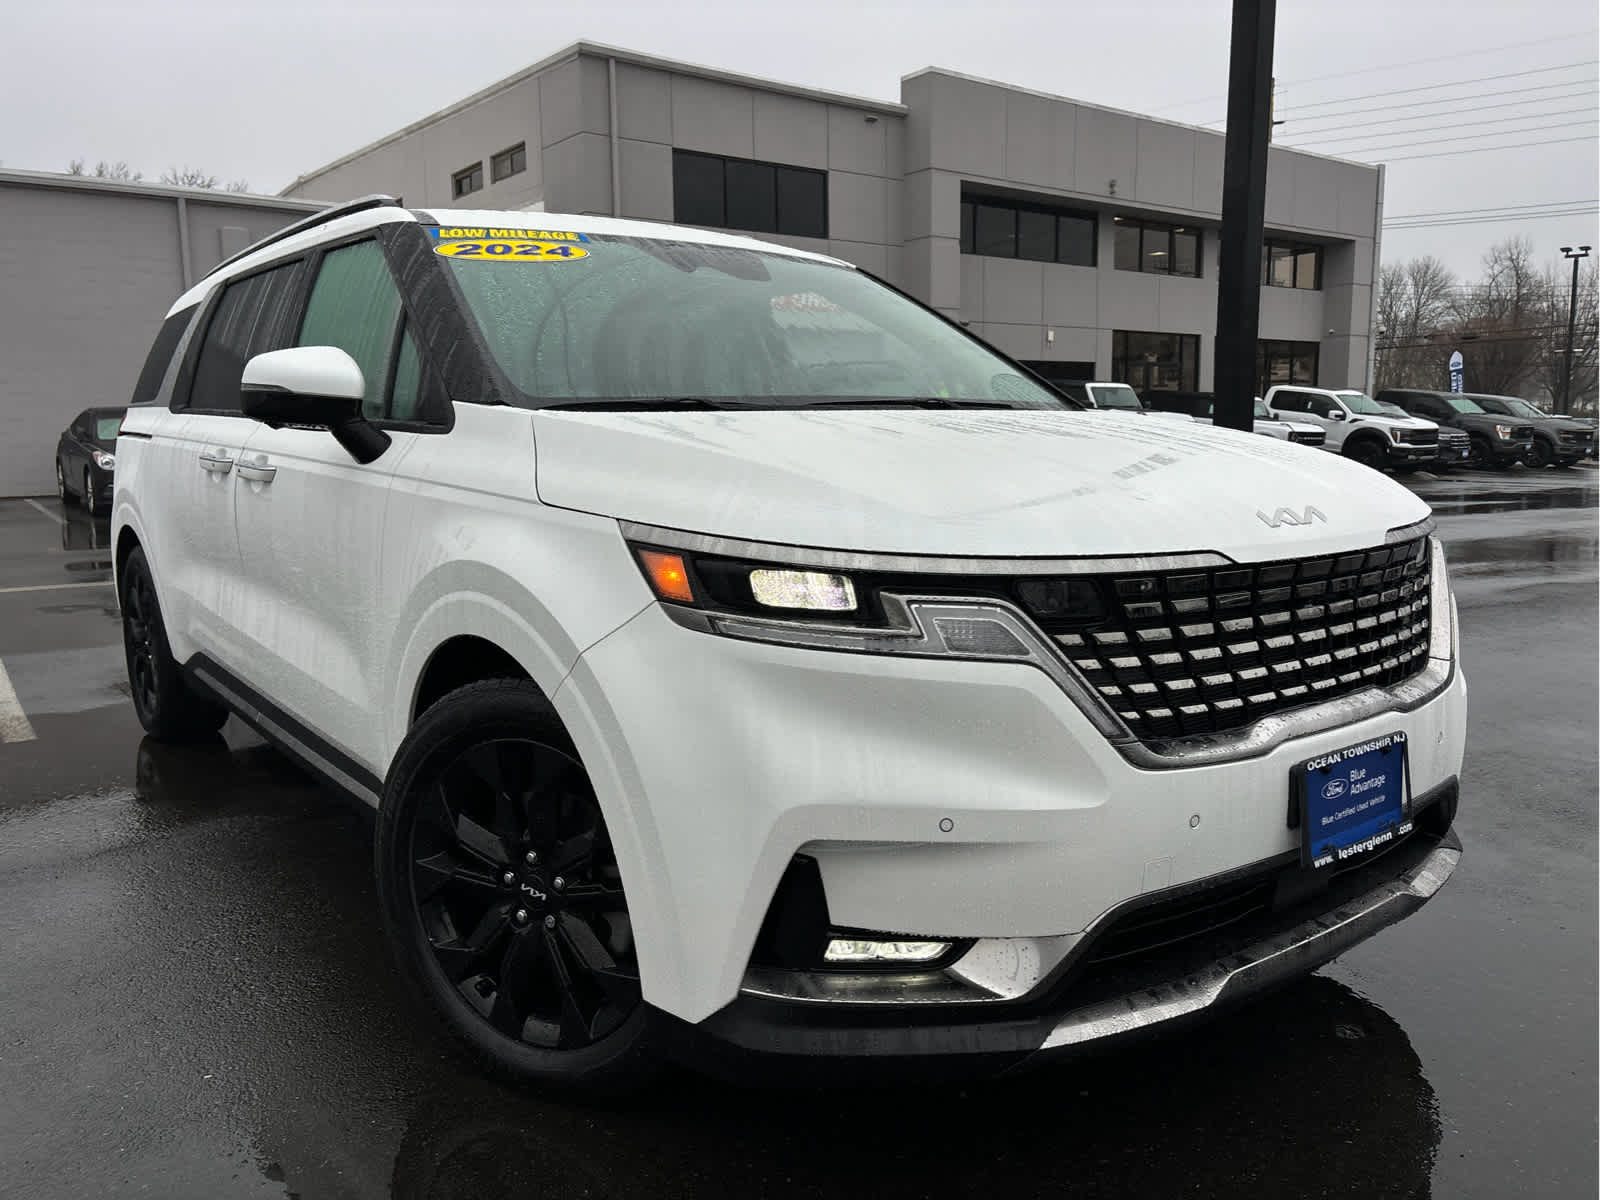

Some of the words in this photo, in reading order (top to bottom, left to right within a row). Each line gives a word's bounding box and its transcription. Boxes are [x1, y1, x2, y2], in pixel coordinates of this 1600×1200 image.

[439, 228, 487, 239] LOW
[489, 228, 580, 242] MILEAGE
[454, 243, 573, 258] 2024
[1307, 753, 1341, 771] OCEAN
[1393, 732, 1405, 744] NJ
[1350, 768, 1366, 782] Blue
[1350, 774, 1385, 796] Advantage
[1321, 816, 1334, 826] Blue
[1335, 806, 1356, 820] Certified
[1357, 800, 1369, 812] Used
[1338, 831, 1393, 860] lesterglenn
